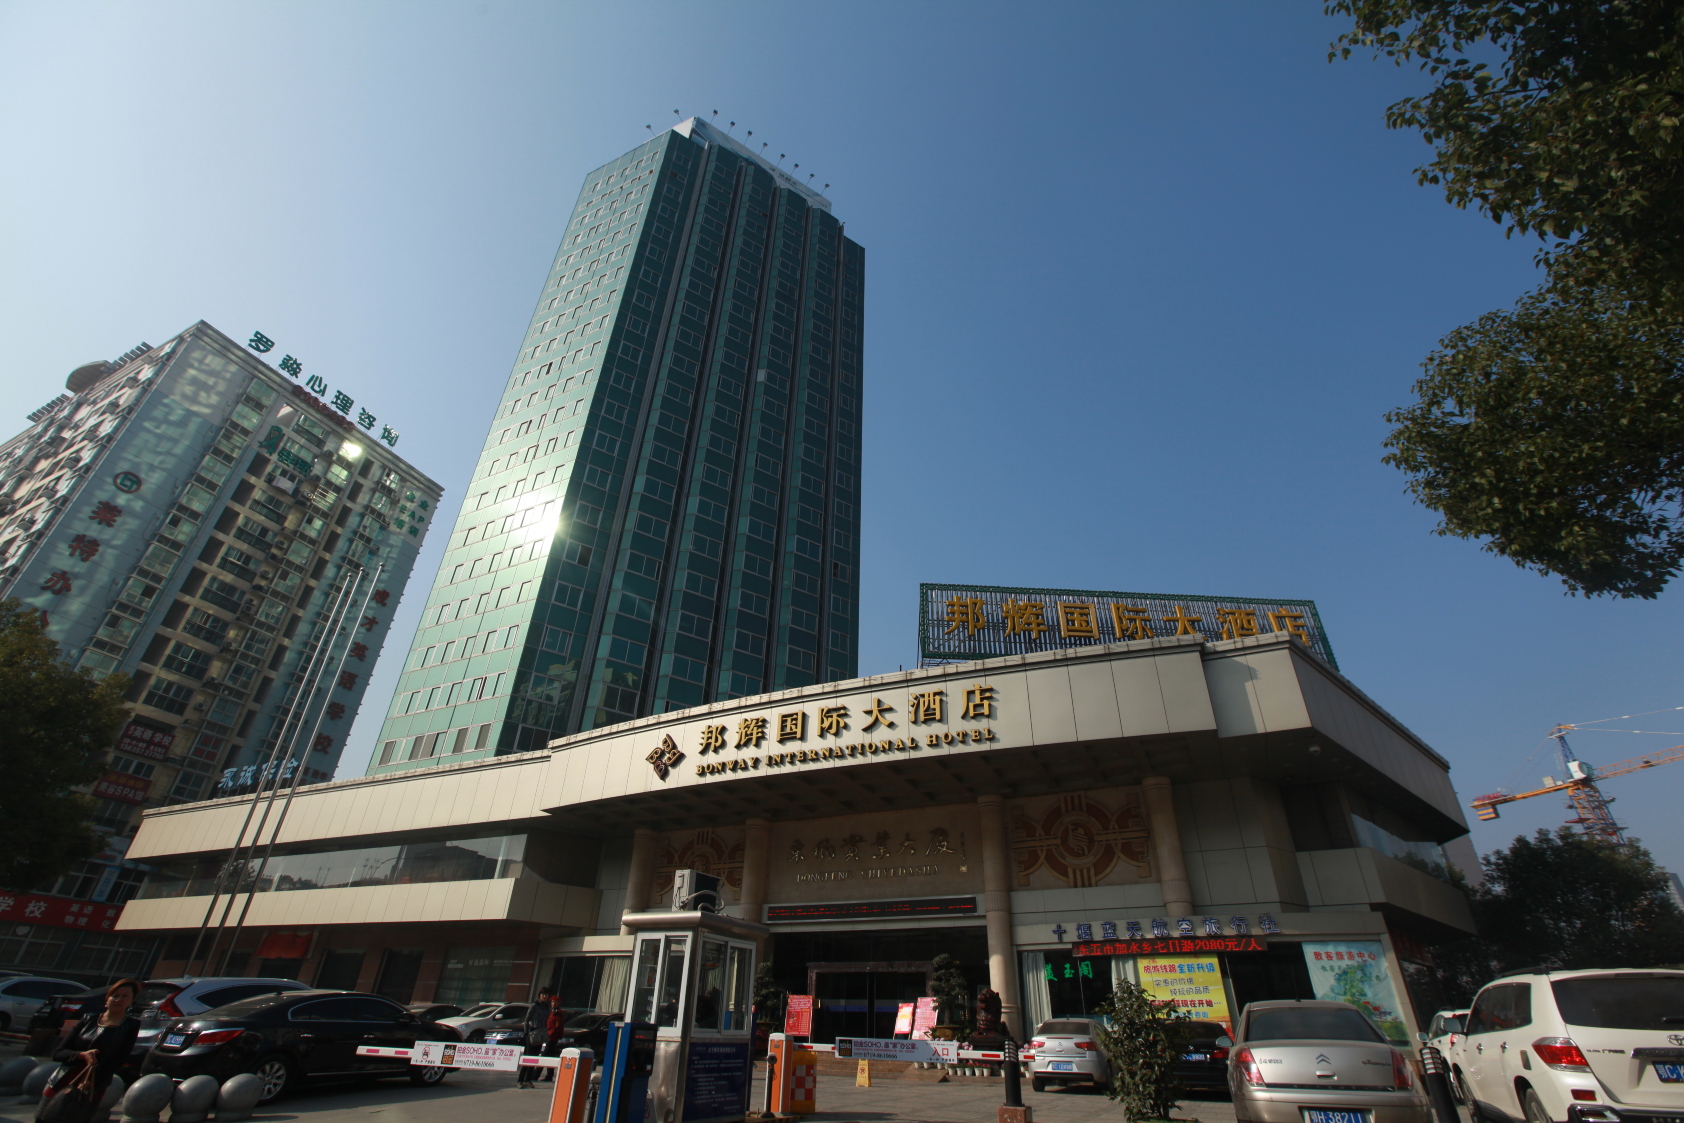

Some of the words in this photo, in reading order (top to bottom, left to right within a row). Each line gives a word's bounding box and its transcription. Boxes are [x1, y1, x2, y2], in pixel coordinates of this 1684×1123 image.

[399, 504, 425, 523] EAP
[945, 595, 1311, 646] 邦辉国际大酒店
[698, 683, 994, 754] 邦辉国际大酒店
[695, 756, 759, 775] BONWAY
[765, 737, 917, 766] INTERNATIONAL
[926, 727, 994, 747] HOTEL
[796, 871, 852, 883] DONGFENG
[1051, 914, 1280, 942] 十堰蓝天航空旅行社
[1313, 951, 1377, 961] 散客旅游中心
[1154, 977, 1195, 987] 实惠的价格
[1169, 985, 1211, 996] 纯玩的品质
[931, 1046, 950, 1057] 入口
